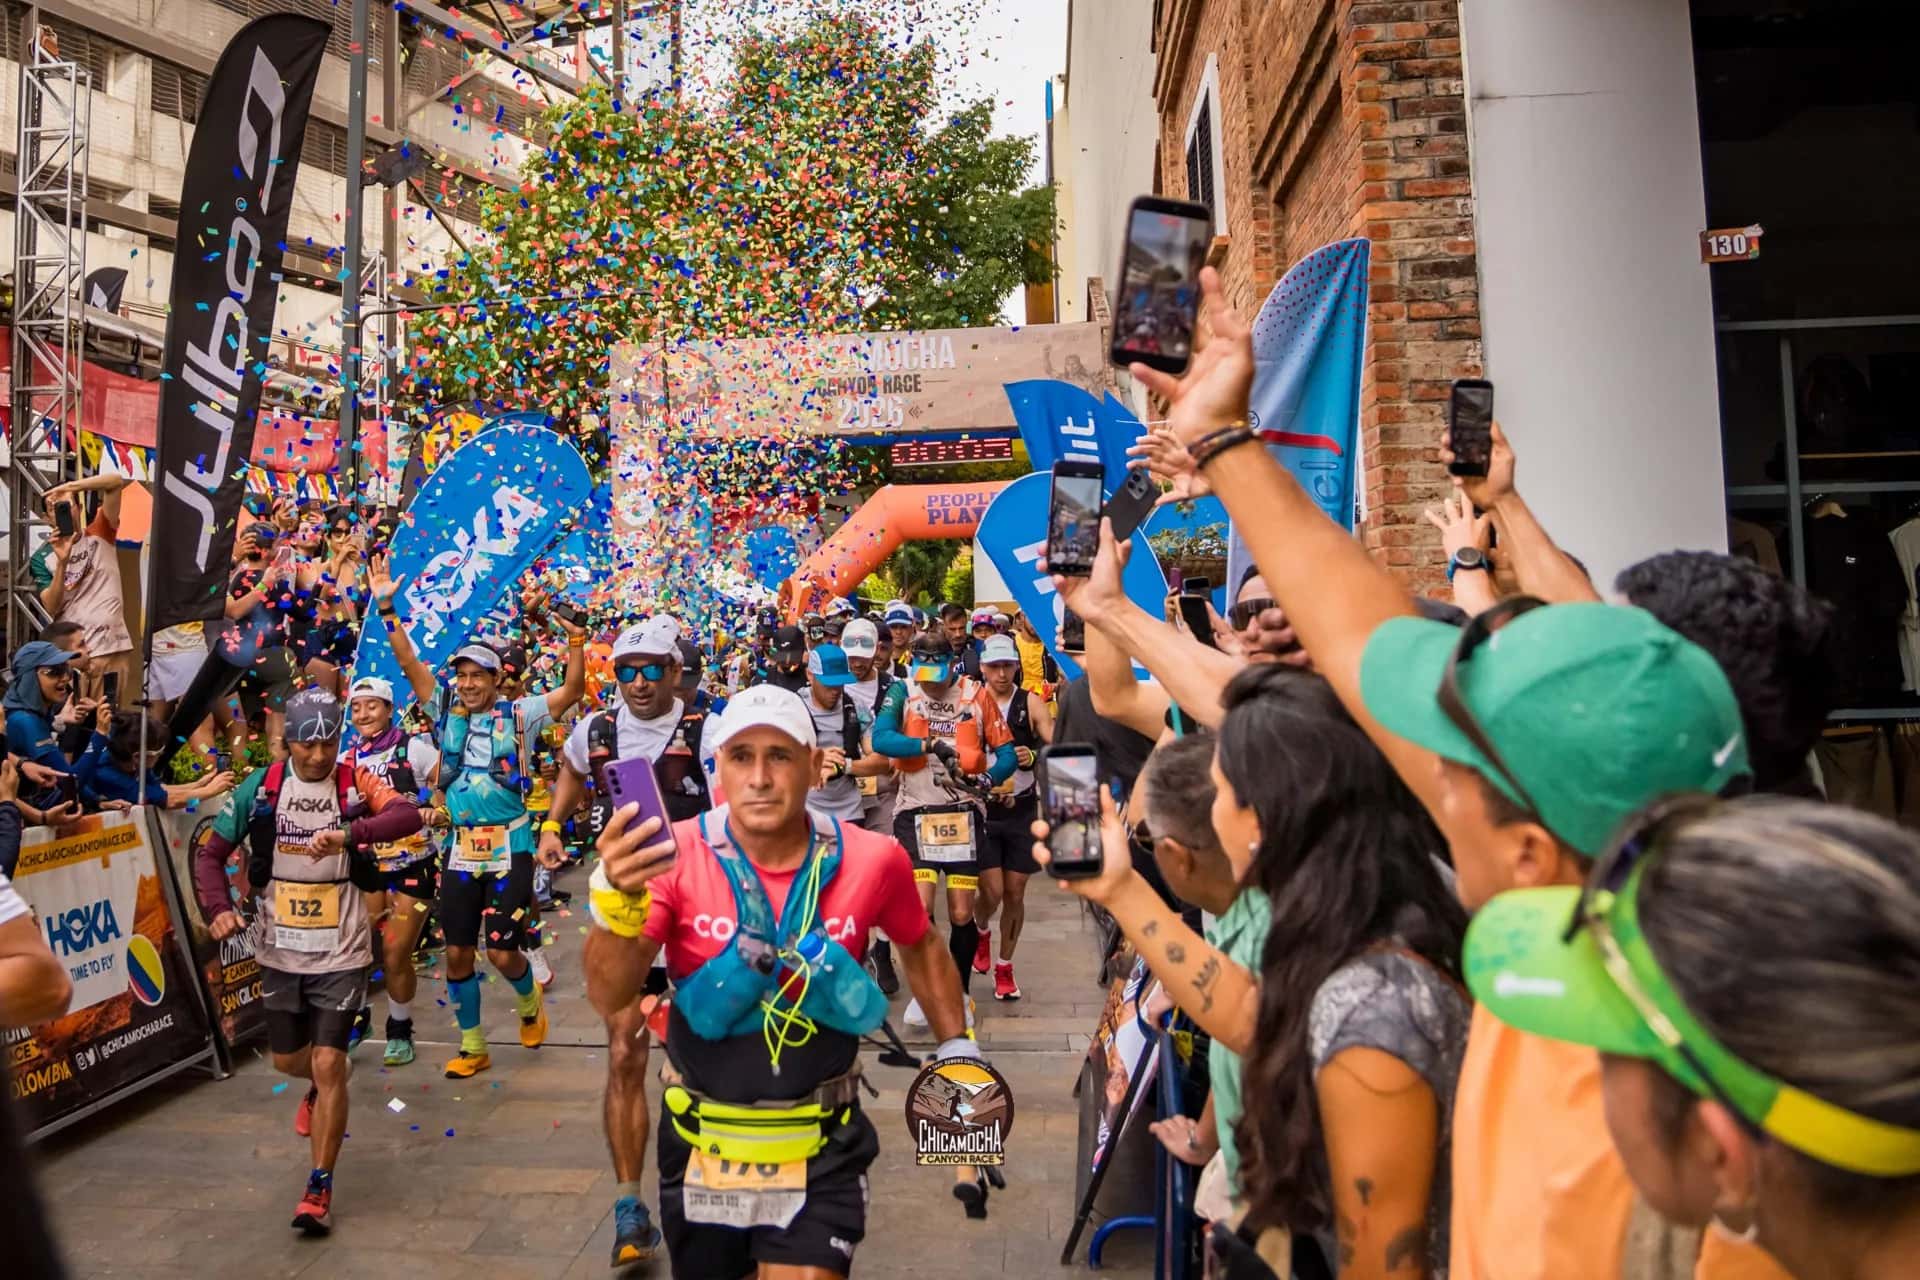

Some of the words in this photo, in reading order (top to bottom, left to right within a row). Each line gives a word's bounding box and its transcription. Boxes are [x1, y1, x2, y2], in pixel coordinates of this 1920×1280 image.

[1707, 233, 1747, 256] 130
[165, 216, 260, 575] Julbo
[883, 373, 922, 394] RACE
[837, 395, 904, 430] 2026
[287, 797, 334, 813] HOKA
[932, 824, 958, 837] 165
[289, 899, 323, 917] 132
[45, 899, 121, 957] HOKA
[70, 964, 88, 982] TIME
[89, 960, 100, 976] TO
[101, 954, 114, 972] FLY
[16, 1060, 73, 1097] LOMBIA
